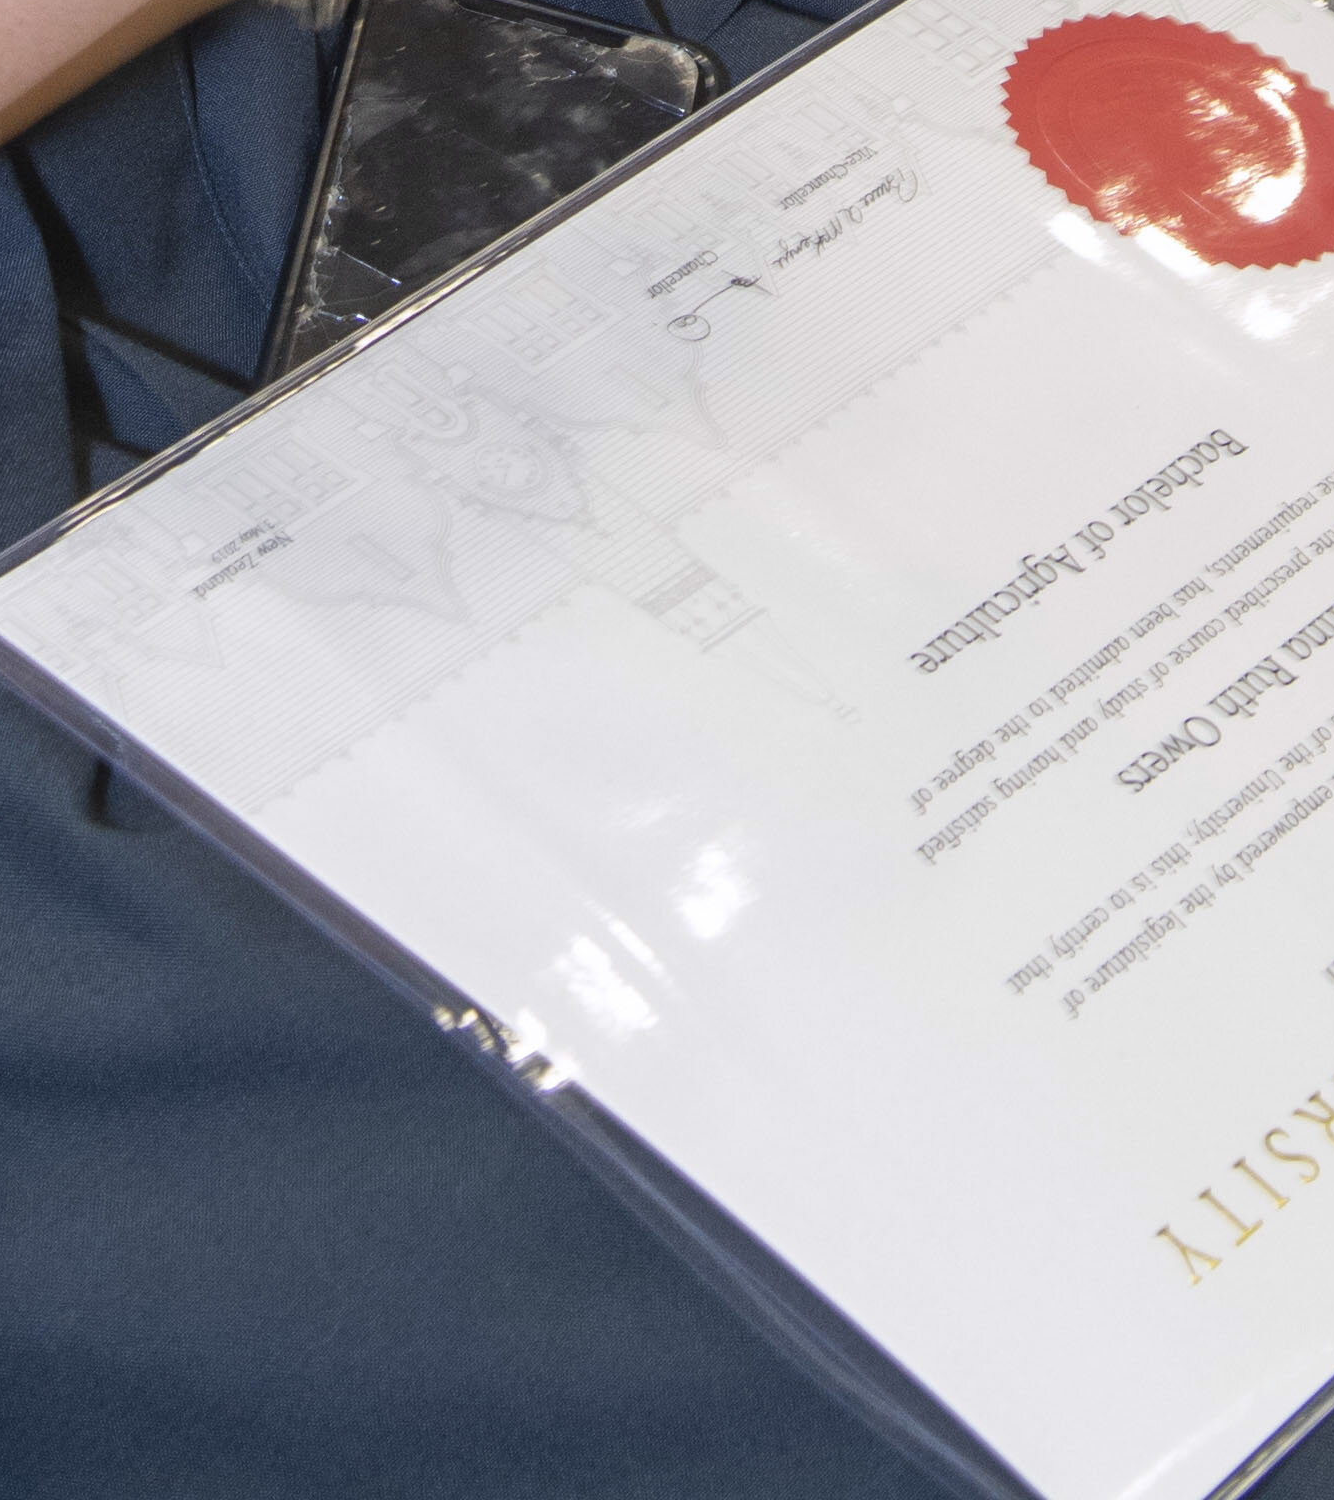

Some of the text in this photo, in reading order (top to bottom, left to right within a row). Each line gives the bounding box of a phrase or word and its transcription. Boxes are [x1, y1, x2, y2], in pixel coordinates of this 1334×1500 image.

[646, 146, 878, 299] Vice-Chancellor Chancellor
[908, 429, 1249, 674] Bachelor of Agriculture
[1204, 492, 1319, 577] requirements,
[191, 531, 294, 599] New Zealand
[1221, 547, 1312, 626] prescribed
[1171, 577, 1214, 607] has
[1128, 602, 1180, 639] been
[1166, 618, 1226, 665] course
[1047, 636, 1130, 705] admitted
[1147, 661, 1170, 689] of
[1207, 655, 1299, 718] Ruth
[1026, 697, 1054, 718] to
[1097, 677, 1148, 720] study
[992, 714, 1031, 744] the
[1057, 717, 1098, 754] and
[1310, 726, 1332, 754] of
[931, 739, 996, 791] degree
[990, 746, 1068, 800] having
[1116, 716, 1222, 793] Owers
[1277, 743, 1314, 772] the
[910, 787, 933, 816] of
[1187, 769, 1286, 845] University;
[915, 795, 997, 866] satisfied
[1233, 785, 1333, 873] empowered
[1149, 842, 1192, 876] this
[1211, 863, 1244, 888] by
[1107, 888, 1136, 911] to
[1129, 871, 1157, 893] is
[1178, 884, 1216, 915] the
[1049, 907, 1110, 959] certify
[1083, 910, 1187, 993] legislature
[1005, 954, 1054, 995] that
[1062, 988, 1086, 1020] of
